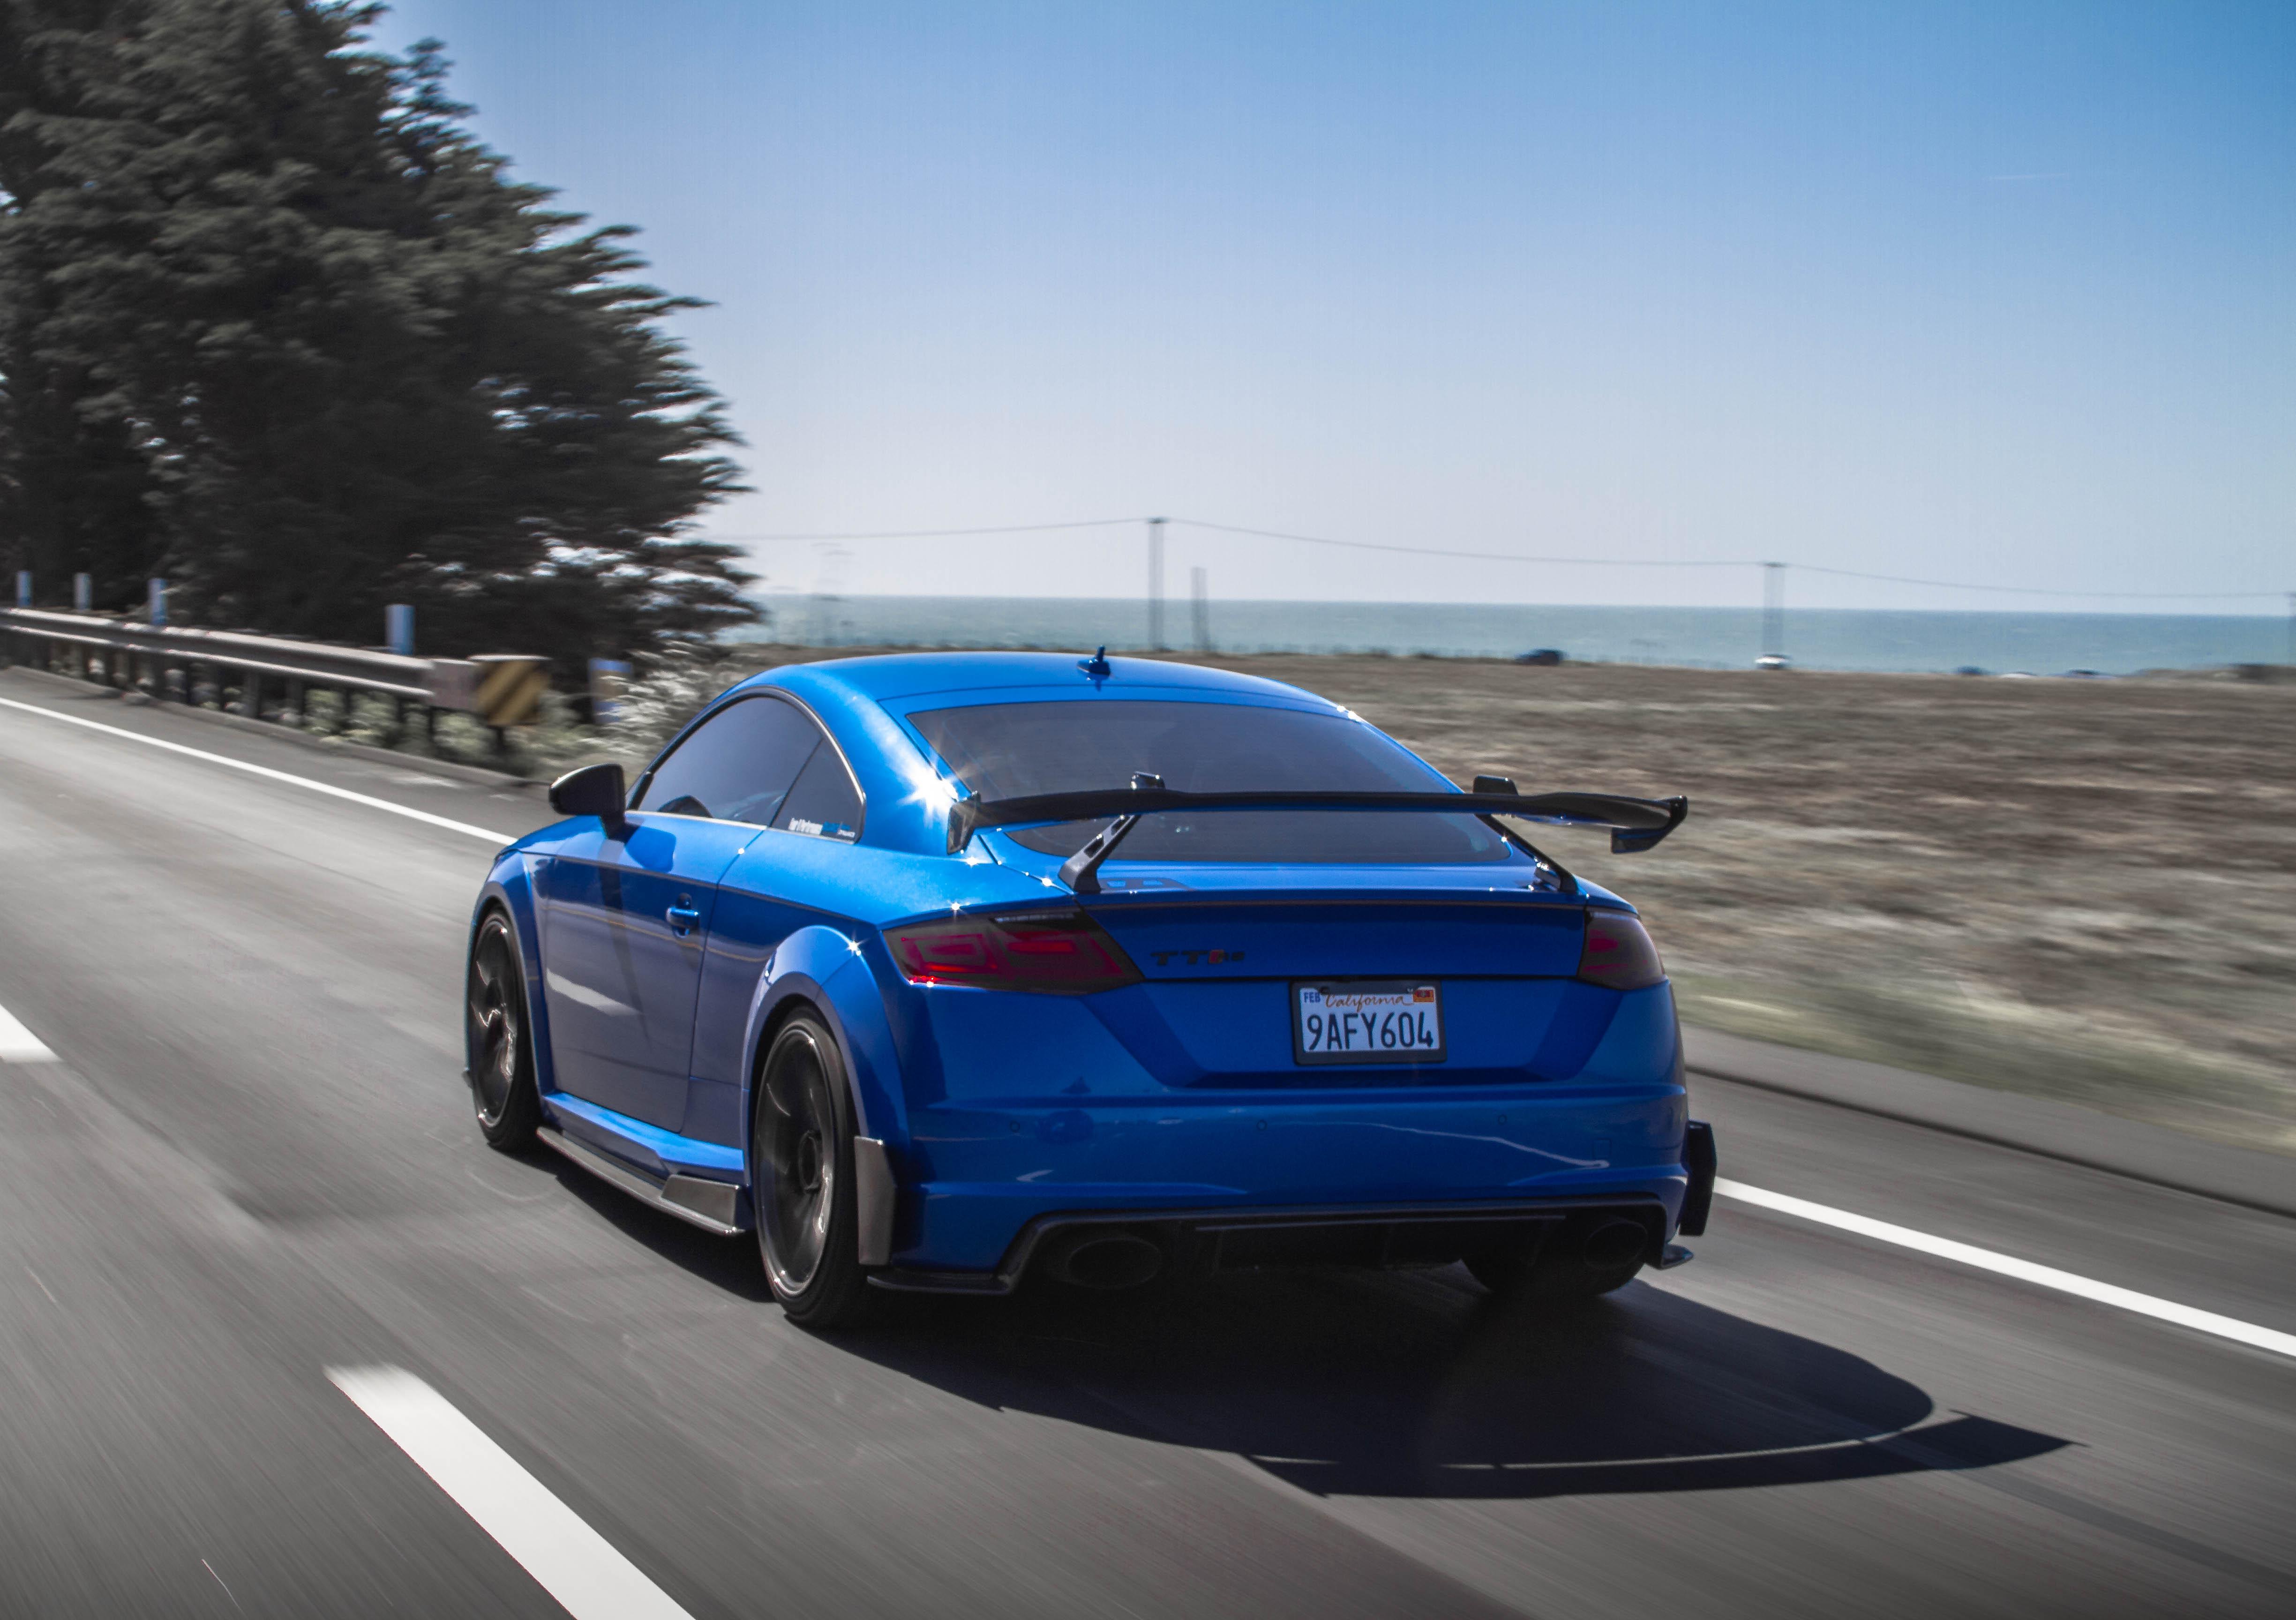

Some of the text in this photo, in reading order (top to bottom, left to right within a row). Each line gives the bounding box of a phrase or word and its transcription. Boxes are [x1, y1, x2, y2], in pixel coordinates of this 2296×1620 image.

[1304, 991, 1321, 1003] FEB
[1325, 993, 1414, 1012] California
[1306, 1011, 1434, 1050] 9AFY604
